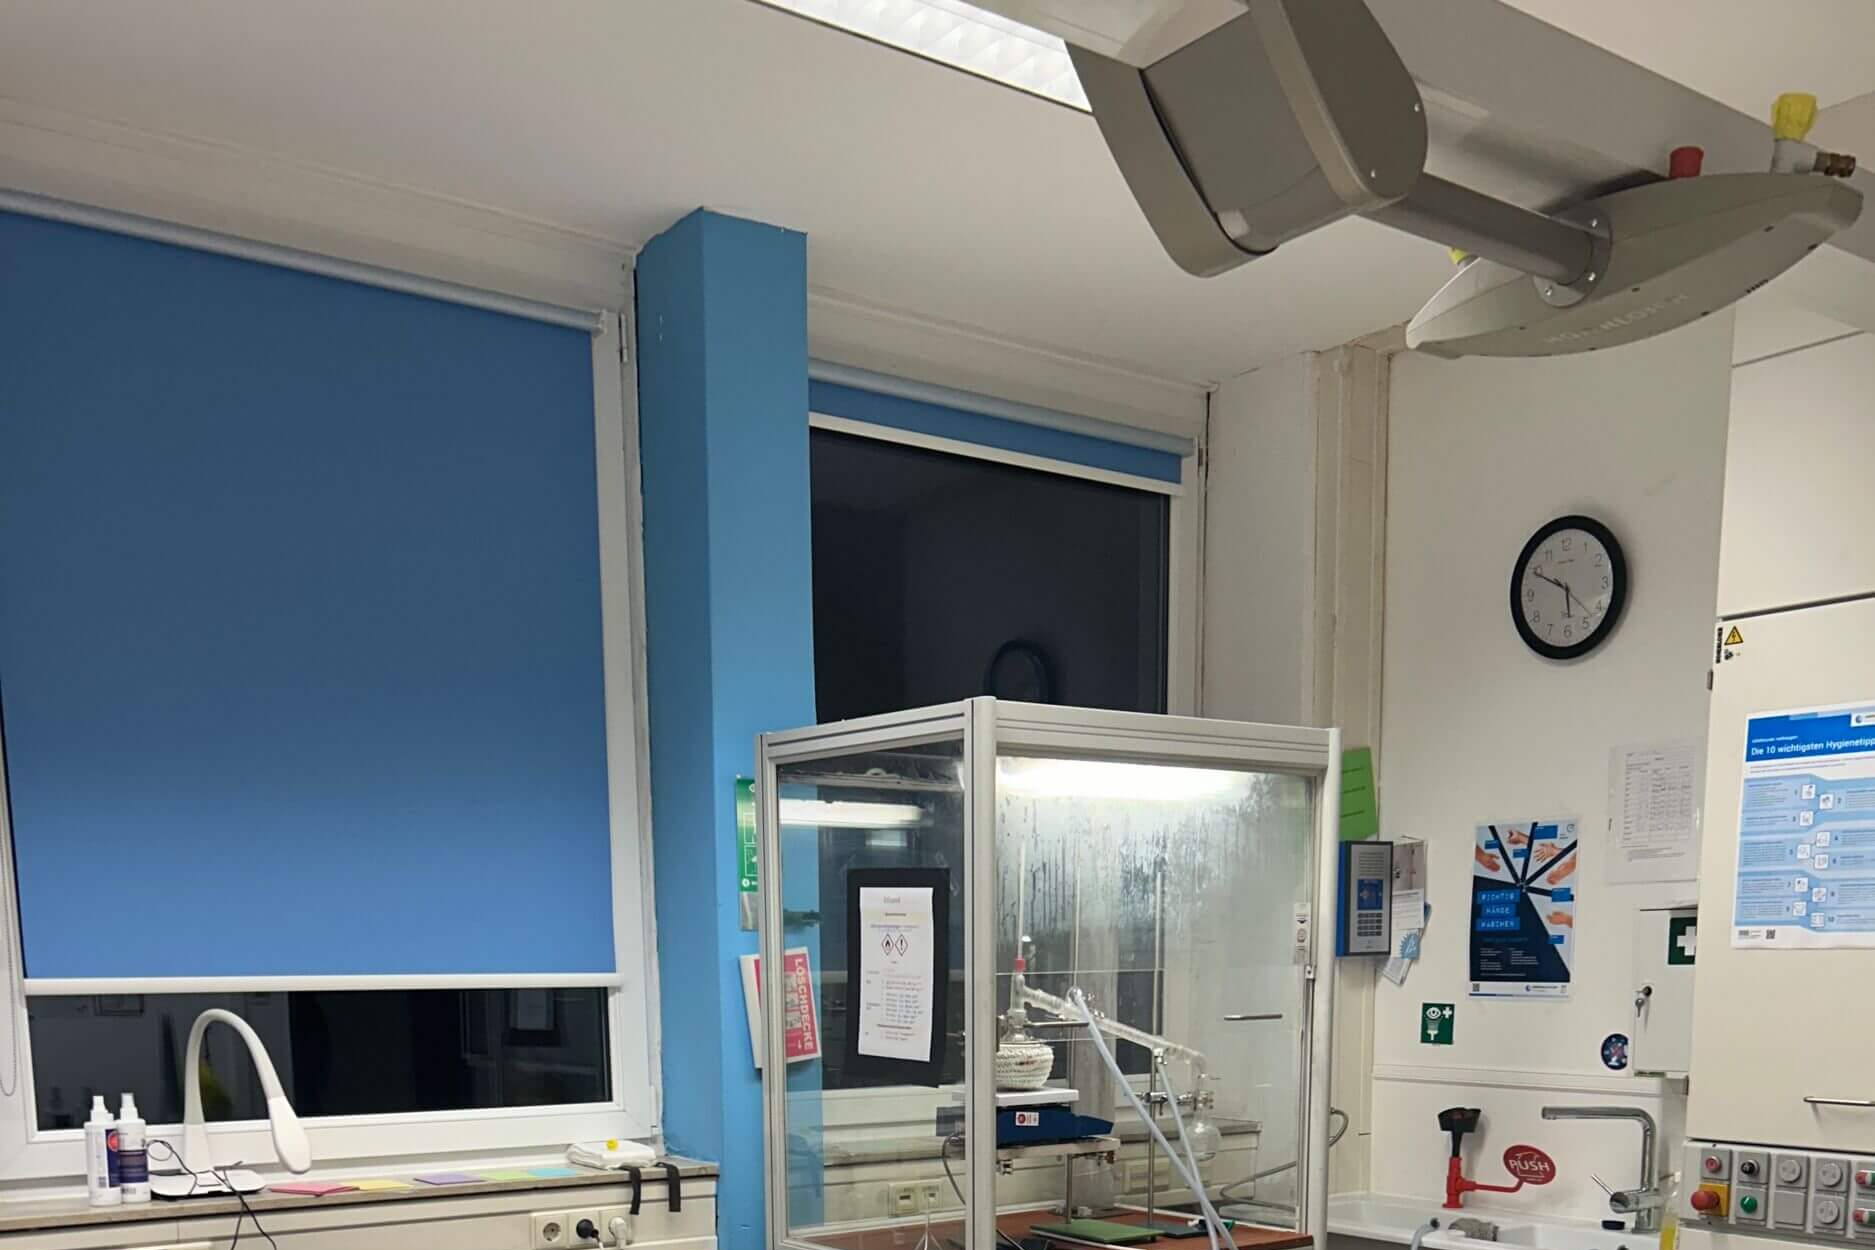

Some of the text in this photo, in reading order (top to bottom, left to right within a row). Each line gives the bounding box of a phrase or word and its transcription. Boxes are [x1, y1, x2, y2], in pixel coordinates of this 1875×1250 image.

[1562, 537, 1573, 552] 12
[1595, 553, 1603, 567] 2
[1601, 576, 1609, 589] 3
[1527, 589, 1535, 602] 9
[1532, 611, 1540, 623] 8
[1582, 617, 1589, 630] 5
[1547, 624, 1554, 635] 7
[1563, 625, 1572, 638] 6
[1751, 747, 1764, 756] Die
[1766, 746, 1776, 754] 10
[1777, 741, 1824, 753] wichtigsten
[1508, 1159, 1551, 1172] PUSH
